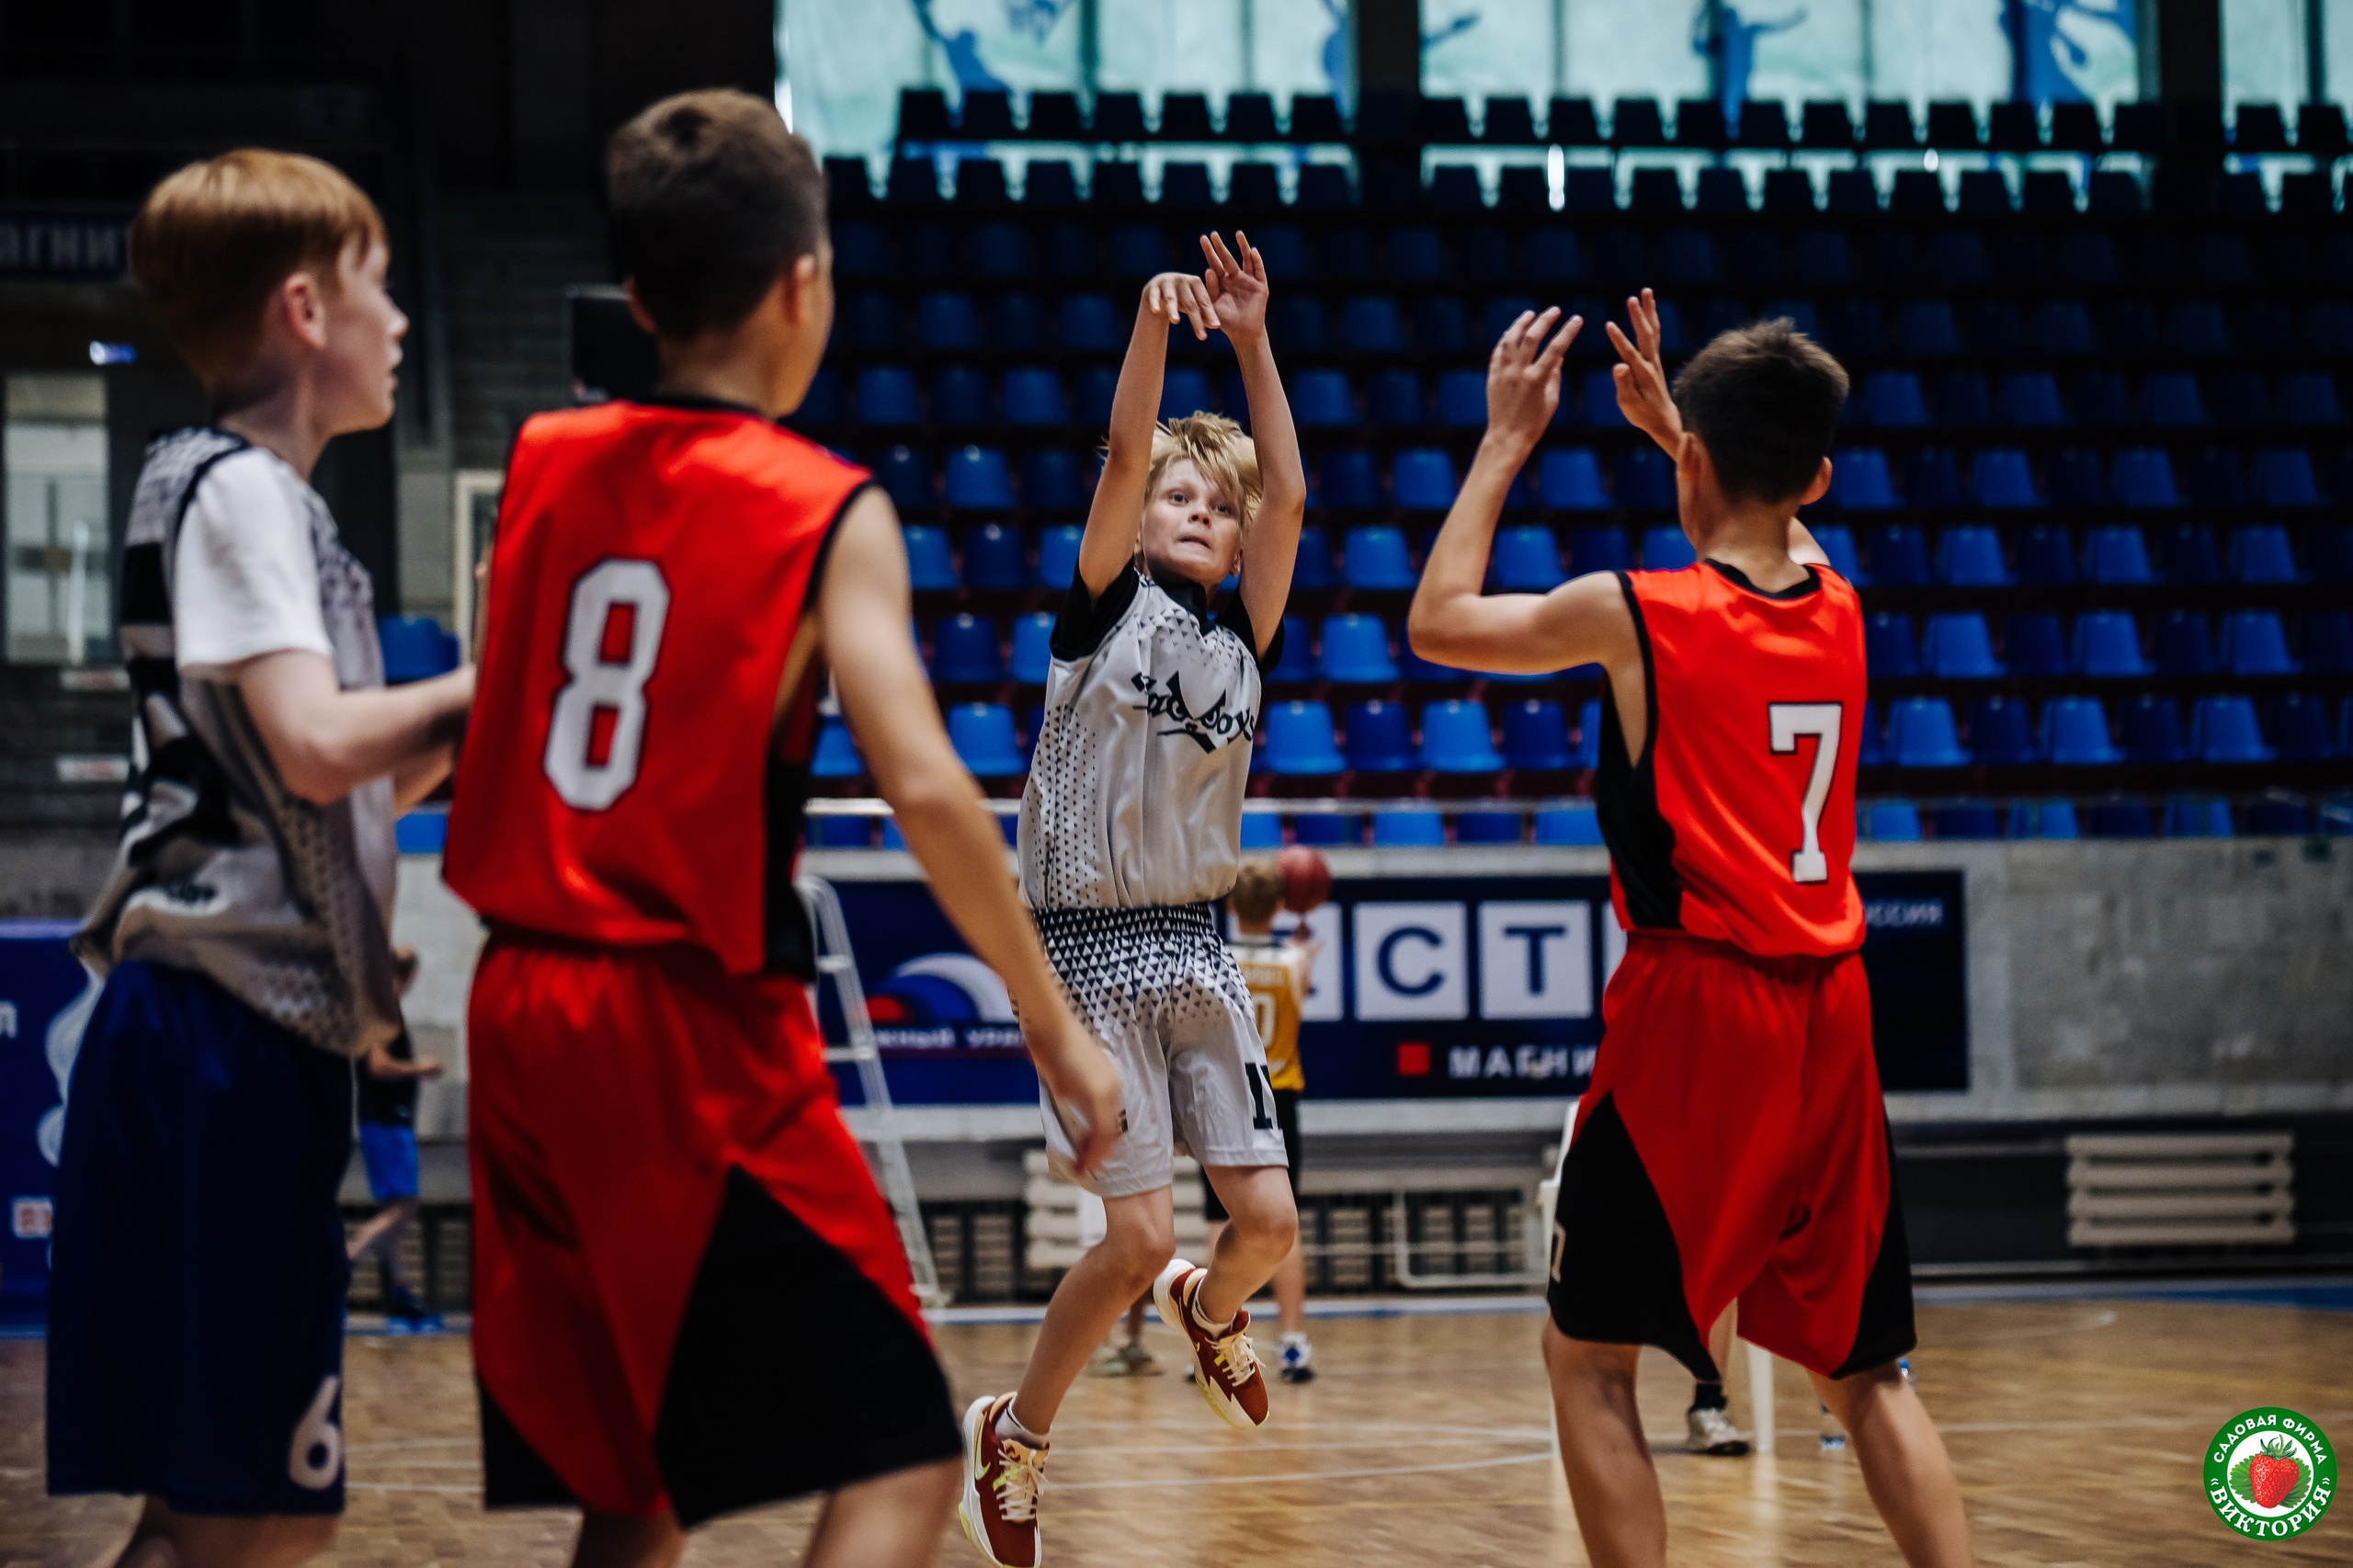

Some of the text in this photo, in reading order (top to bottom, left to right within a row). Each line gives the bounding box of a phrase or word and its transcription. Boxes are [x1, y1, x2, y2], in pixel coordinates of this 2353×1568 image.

[544, 557, 671, 811] 8
[1768, 700, 1843, 885] 7
[288, 1373, 342, 1491] 6
